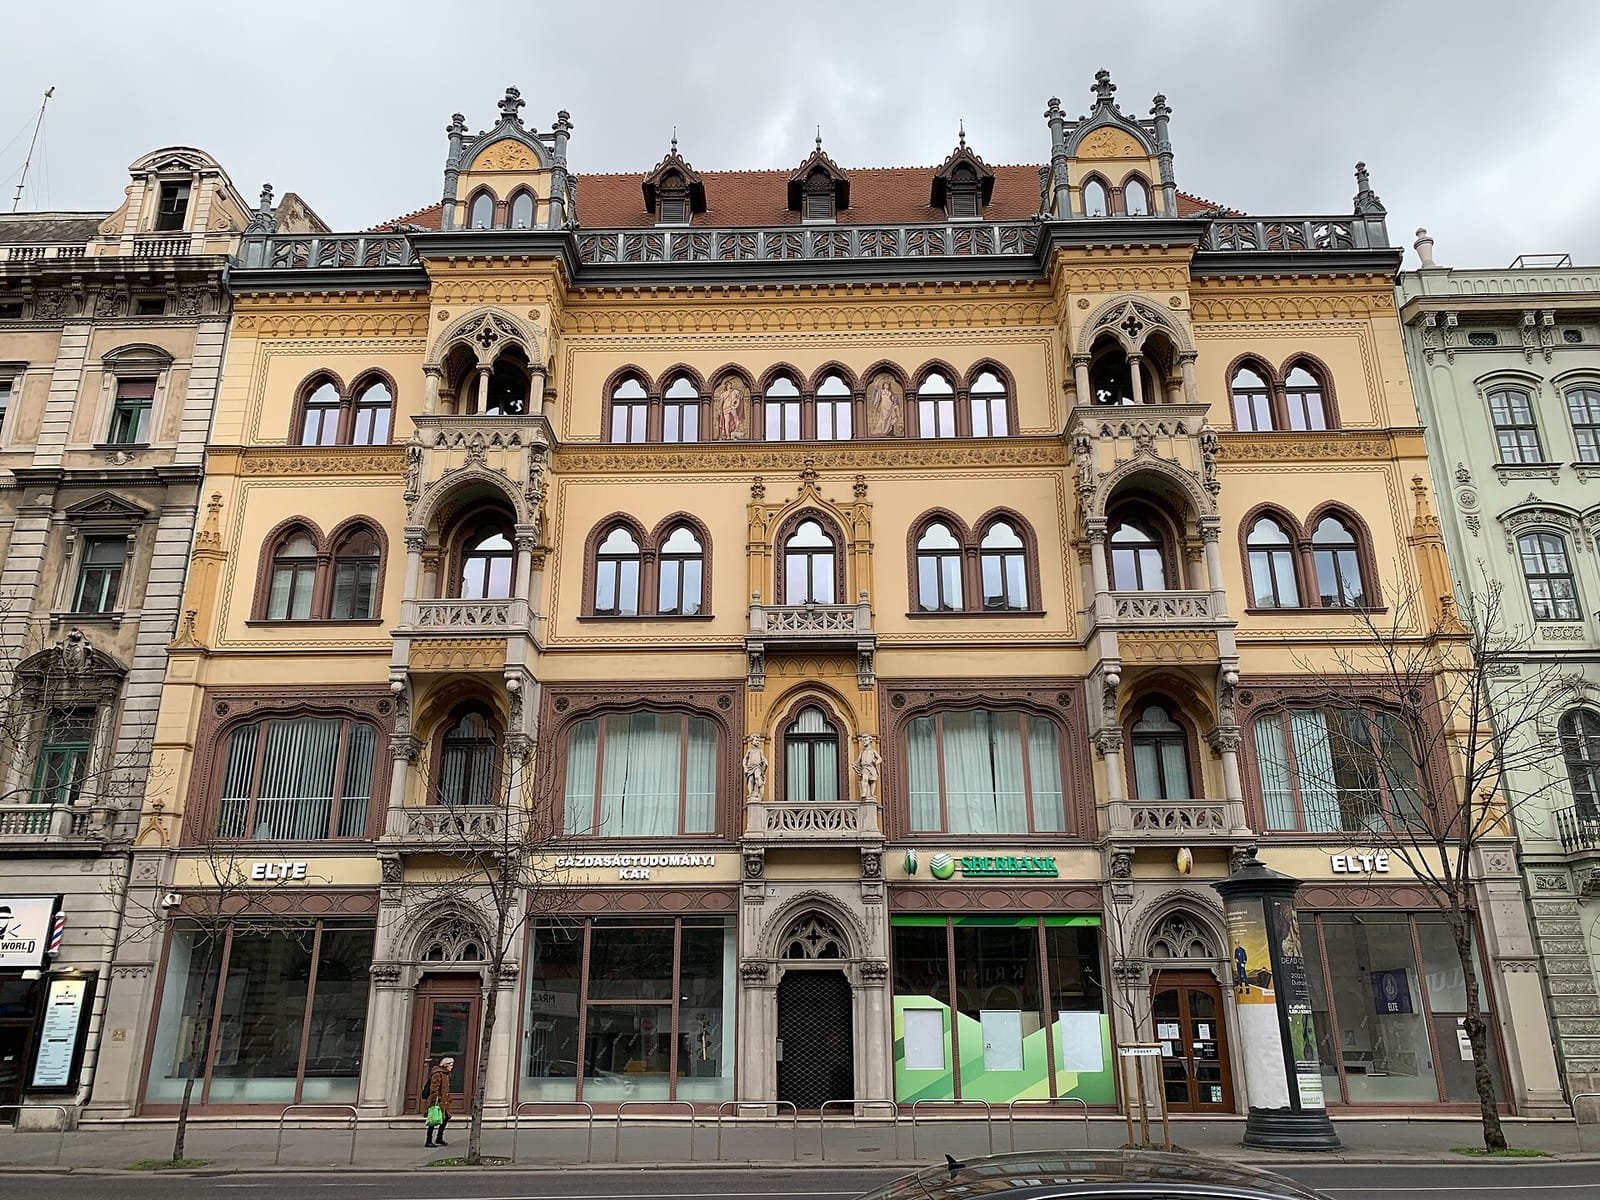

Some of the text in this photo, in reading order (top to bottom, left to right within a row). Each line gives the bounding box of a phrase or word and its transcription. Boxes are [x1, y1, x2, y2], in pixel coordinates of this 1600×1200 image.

[555, 854, 715, 868] GAZDASÁGTUDOMÁNYI
[961, 856, 1058, 872] SBERBANK
[1330, 854, 1390, 873] ELTE
[251, 862, 308, 880] ELTE
[618, 868, 651, 880] KAR
[1, 940, 36, 954] WORLD
